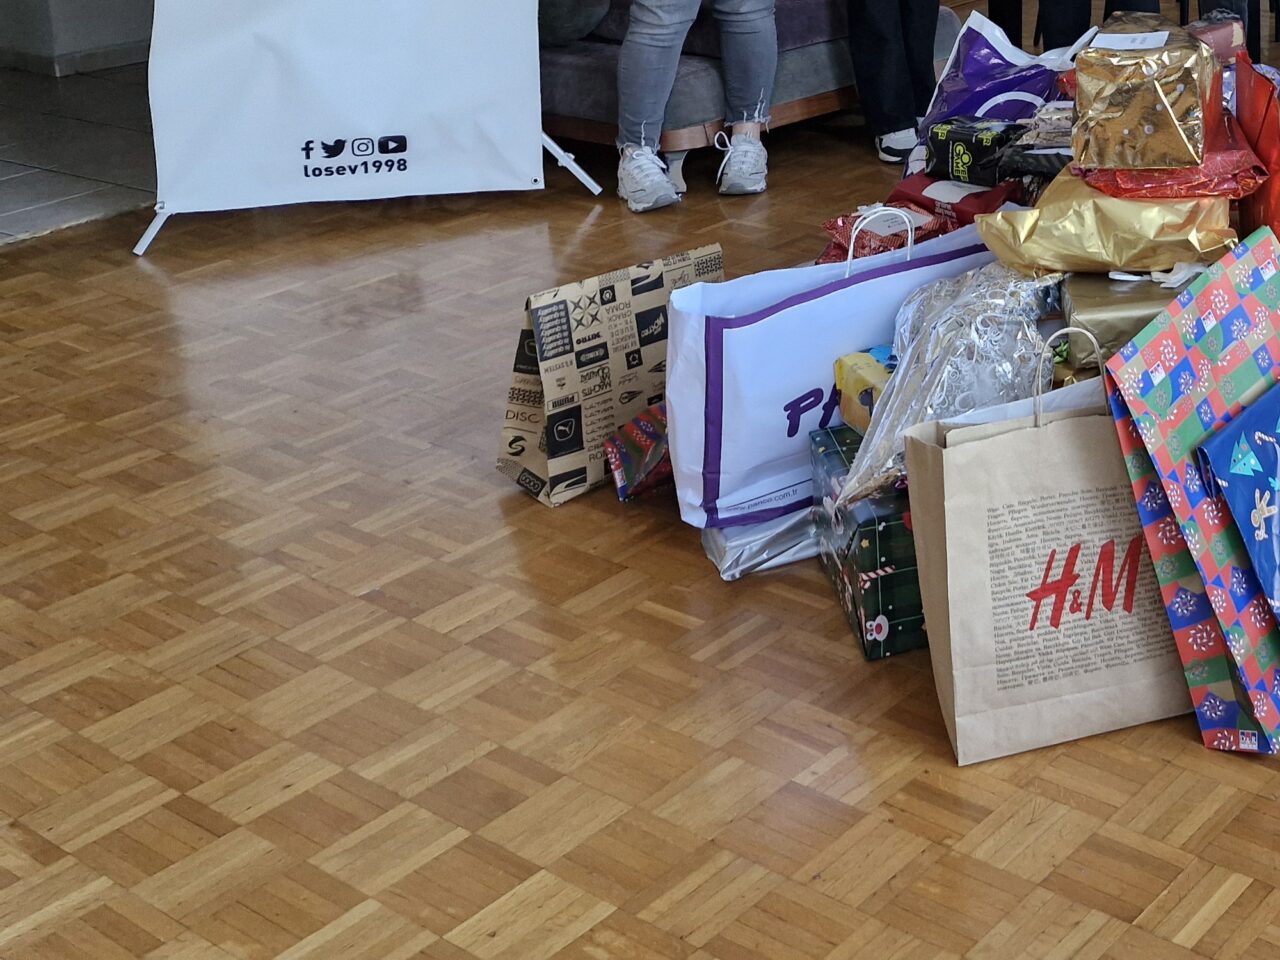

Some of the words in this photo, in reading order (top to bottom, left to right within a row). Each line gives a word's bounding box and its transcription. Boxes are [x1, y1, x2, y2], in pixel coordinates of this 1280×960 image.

[303, 158, 408, 178] losev1998
[605, 300, 631, 314] ROMA
[505, 409, 539, 424] DISC
[1026, 536, 1143, 631] H&M
